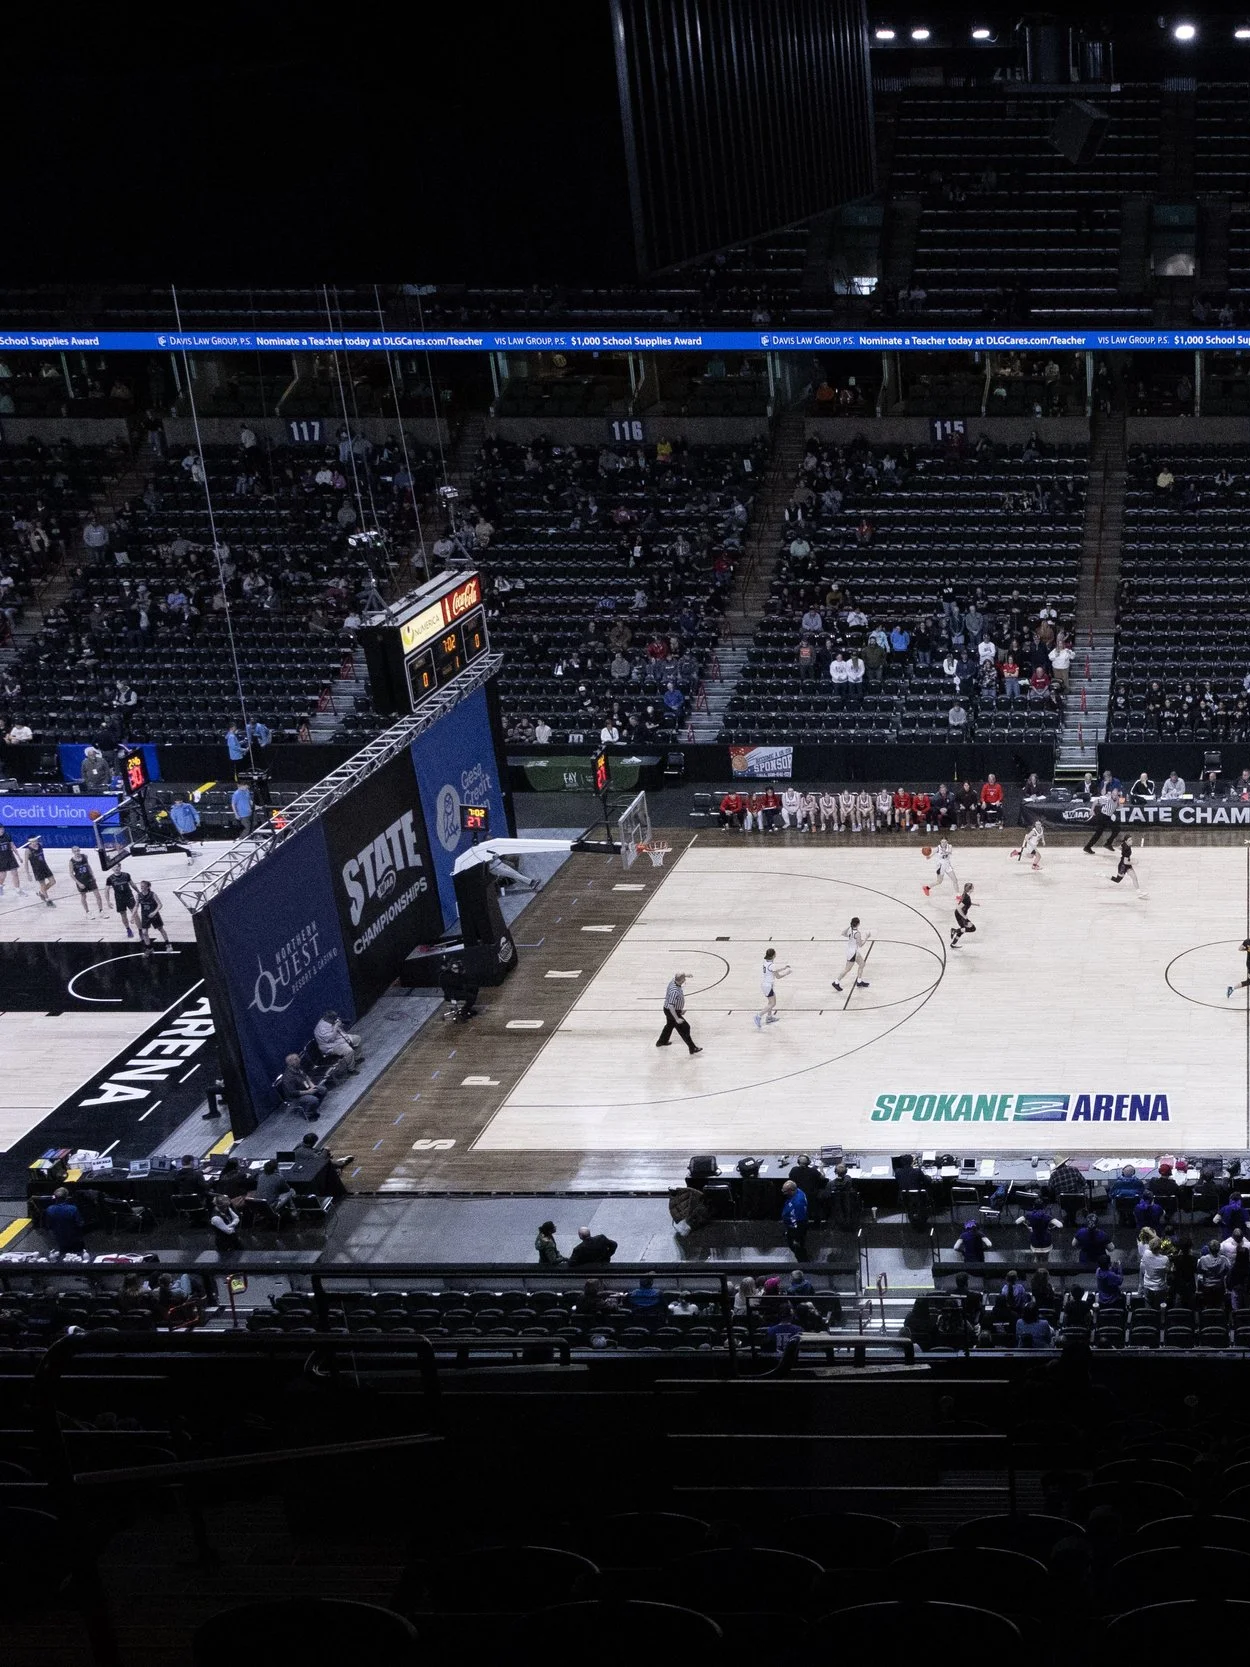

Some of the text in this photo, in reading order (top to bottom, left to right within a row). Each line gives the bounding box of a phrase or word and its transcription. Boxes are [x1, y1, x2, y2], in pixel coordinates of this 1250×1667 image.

[0, 336, 99, 348] School Supplies Award
[193, 336, 209, 344] LAW
[257, 336, 299, 346] Nominate
[309, 336, 343, 346] Teacher
[345, 336, 370, 348] today
[373, 338, 381, 346] at
[383, 336, 482, 346] DLGCares.com/Teacher
[508, 336, 524, 344] LAW
[571, 336, 600, 346] $1,000
[603, 336, 632, 346] School
[634, 336, 671, 348] Supplies
[674, 336, 702, 346] Award
[797, 336, 812, 344] LAW
[860, 336, 902, 346] Nominate
[912, 336, 944, 346] Teacher
[948, 336, 973, 346] today
[975, 336, 984, 344] at
[986, 336, 1086, 344] DLGCares.com/Teacher
[1111, 336, 1127, 344] LAW
[1175, 336, 1203, 346] $1,000
[1206, 336, 1235, 344] School
[291, 421, 320, 441] 117
[612, 421, 643, 441] 116
[414, 615, 440, 636] NUMERICA
[442, 634, 456, 652] 7:02
[461, 763, 482, 788] Gesa
[463, 776, 492, 804] Credit
[2, 805, 87, 818] Credit Union
[468, 808, 485, 817] 7:02
[1111, 806, 1172, 822] TATE
[467, 816, 481, 828] 27
[342, 809, 422, 926] STATE
[353, 877, 428, 956] CHAMPIONSHIPS
[276, 920, 318, 966] NORTHERN
[248, 932, 320, 1012] QUEST
[292, 966, 312, 995] RESORT
[871, 1094, 1170, 1121] SPOKANE ARENA
